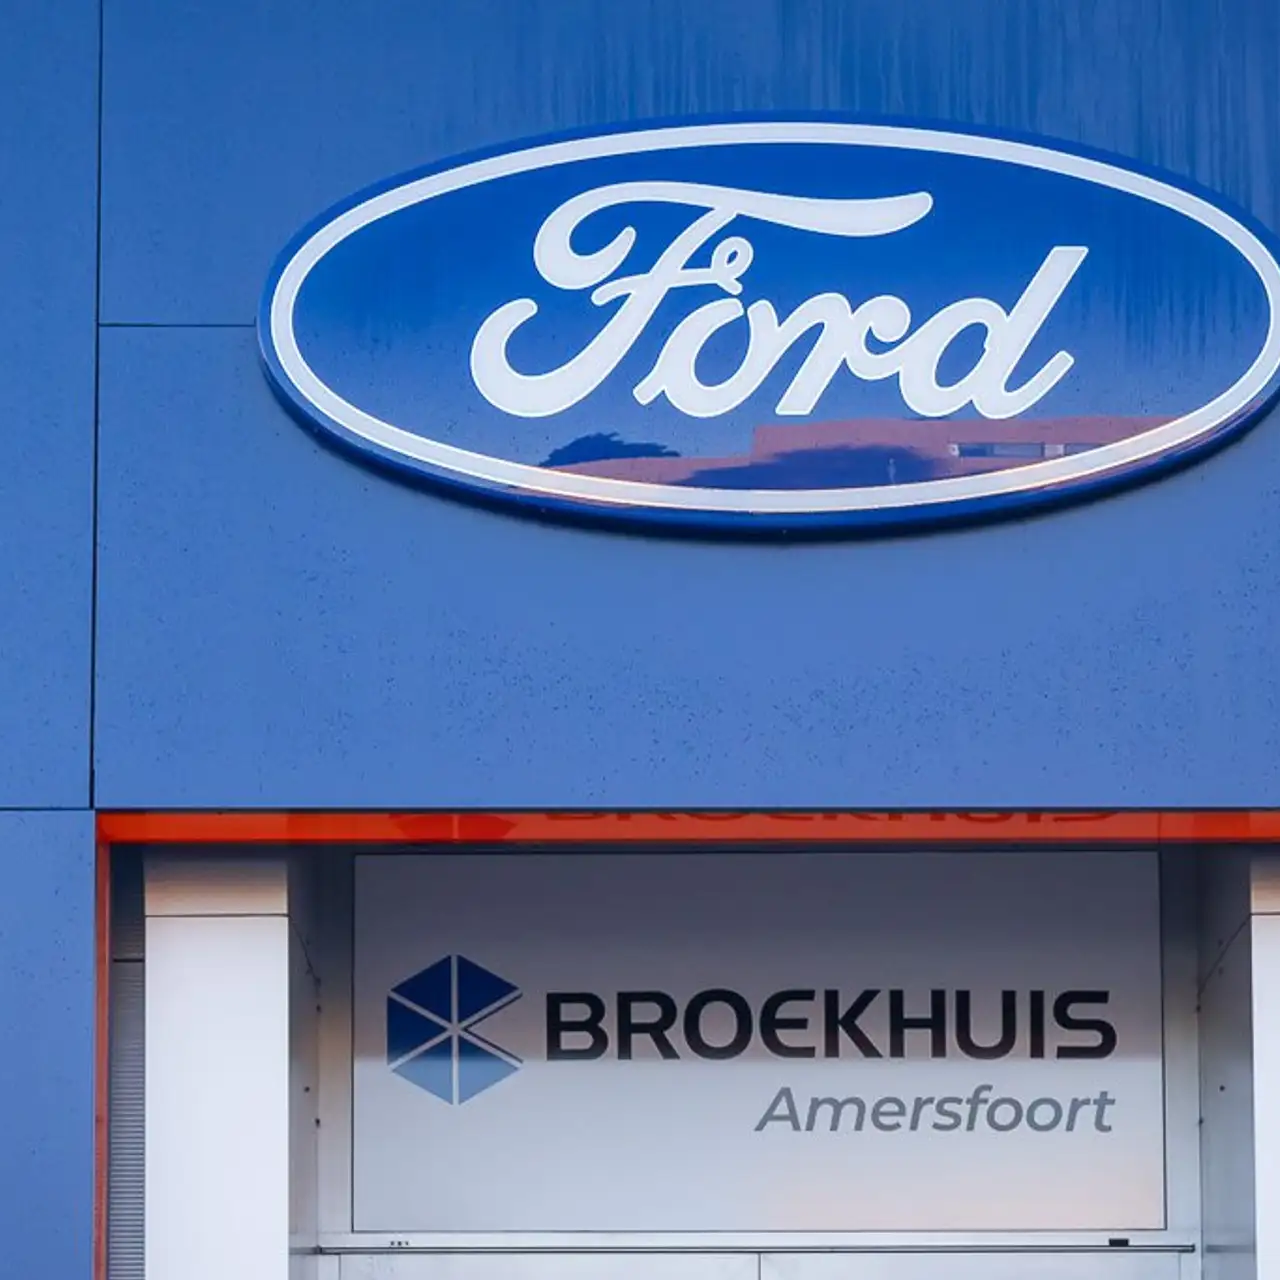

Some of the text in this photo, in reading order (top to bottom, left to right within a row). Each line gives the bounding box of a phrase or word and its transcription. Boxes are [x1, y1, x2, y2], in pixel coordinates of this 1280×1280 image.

[469, 180, 1089, 420] Ford
[545, 987, 1119, 1061] BROEKHUIS
[754, 1084, 1117, 1133] Amersfoort
